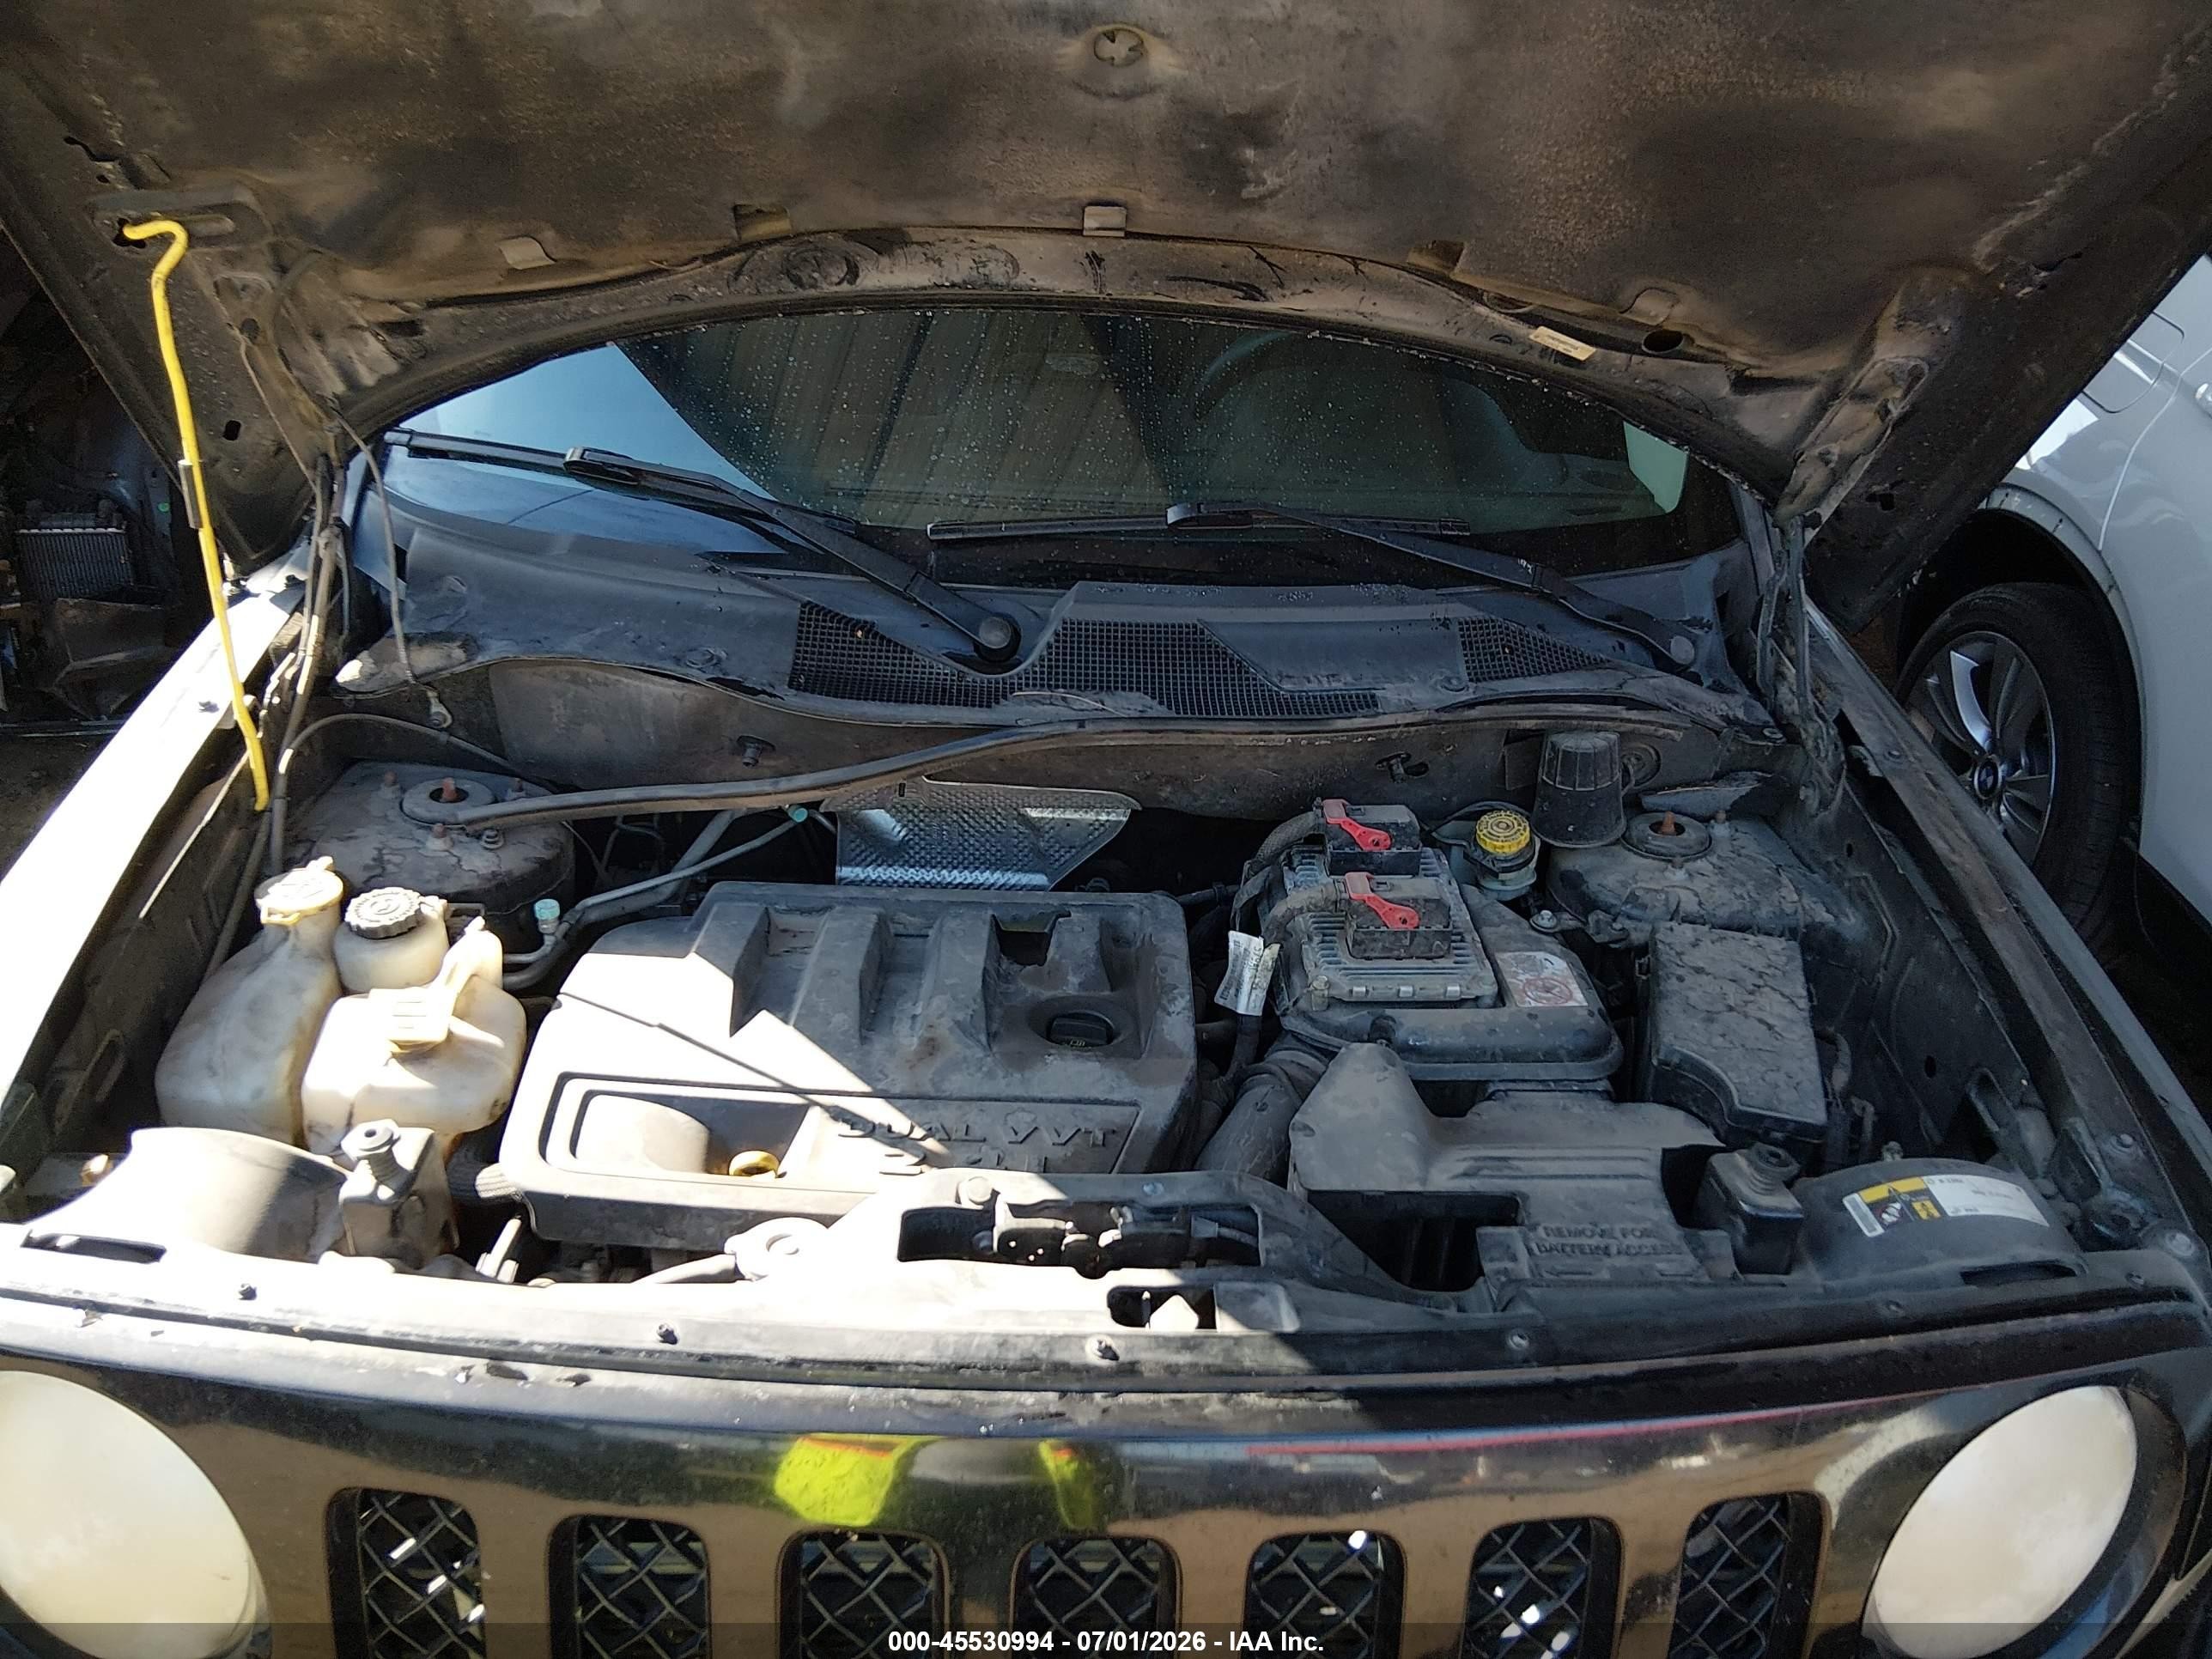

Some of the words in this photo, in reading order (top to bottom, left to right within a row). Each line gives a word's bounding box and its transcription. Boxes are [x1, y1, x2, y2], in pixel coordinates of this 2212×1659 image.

[838, 1119, 987, 1143] DUAL
[1006, 1124, 1116, 1148] VVT
[1541, 1224, 1614, 1239] REMOVE
[1620, 1225, 1660, 1239] FOR
[1534, 1242, 1612, 1257] BATTERY
